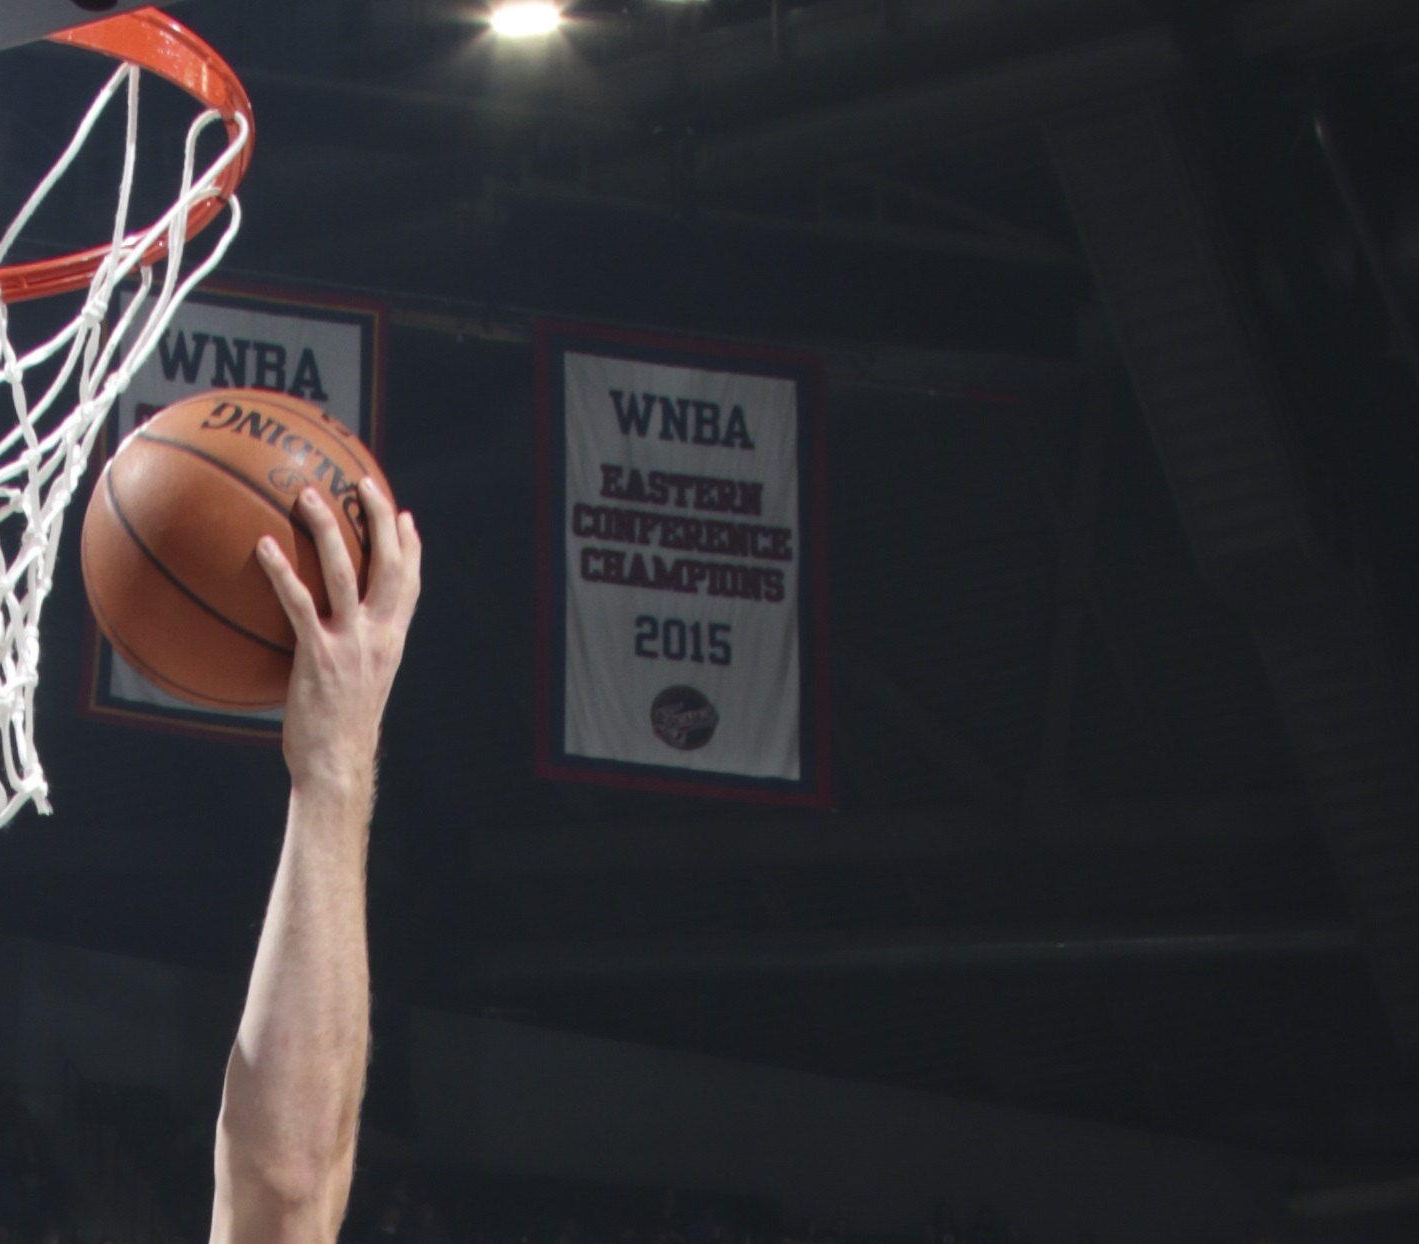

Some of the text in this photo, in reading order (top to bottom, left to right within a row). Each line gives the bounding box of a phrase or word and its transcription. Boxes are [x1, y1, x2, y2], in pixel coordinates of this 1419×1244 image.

[158, 329, 328, 402] WNBA
[609, 388, 755, 451] WNBA
[201, 402, 370, 552] PALDING
[600, 463, 763, 518] EASTERN
[572, 504, 793, 563] CONFERENCE
[580, 547, 785, 603] CHAMPIONS
[634, 615, 733, 667] 2015
